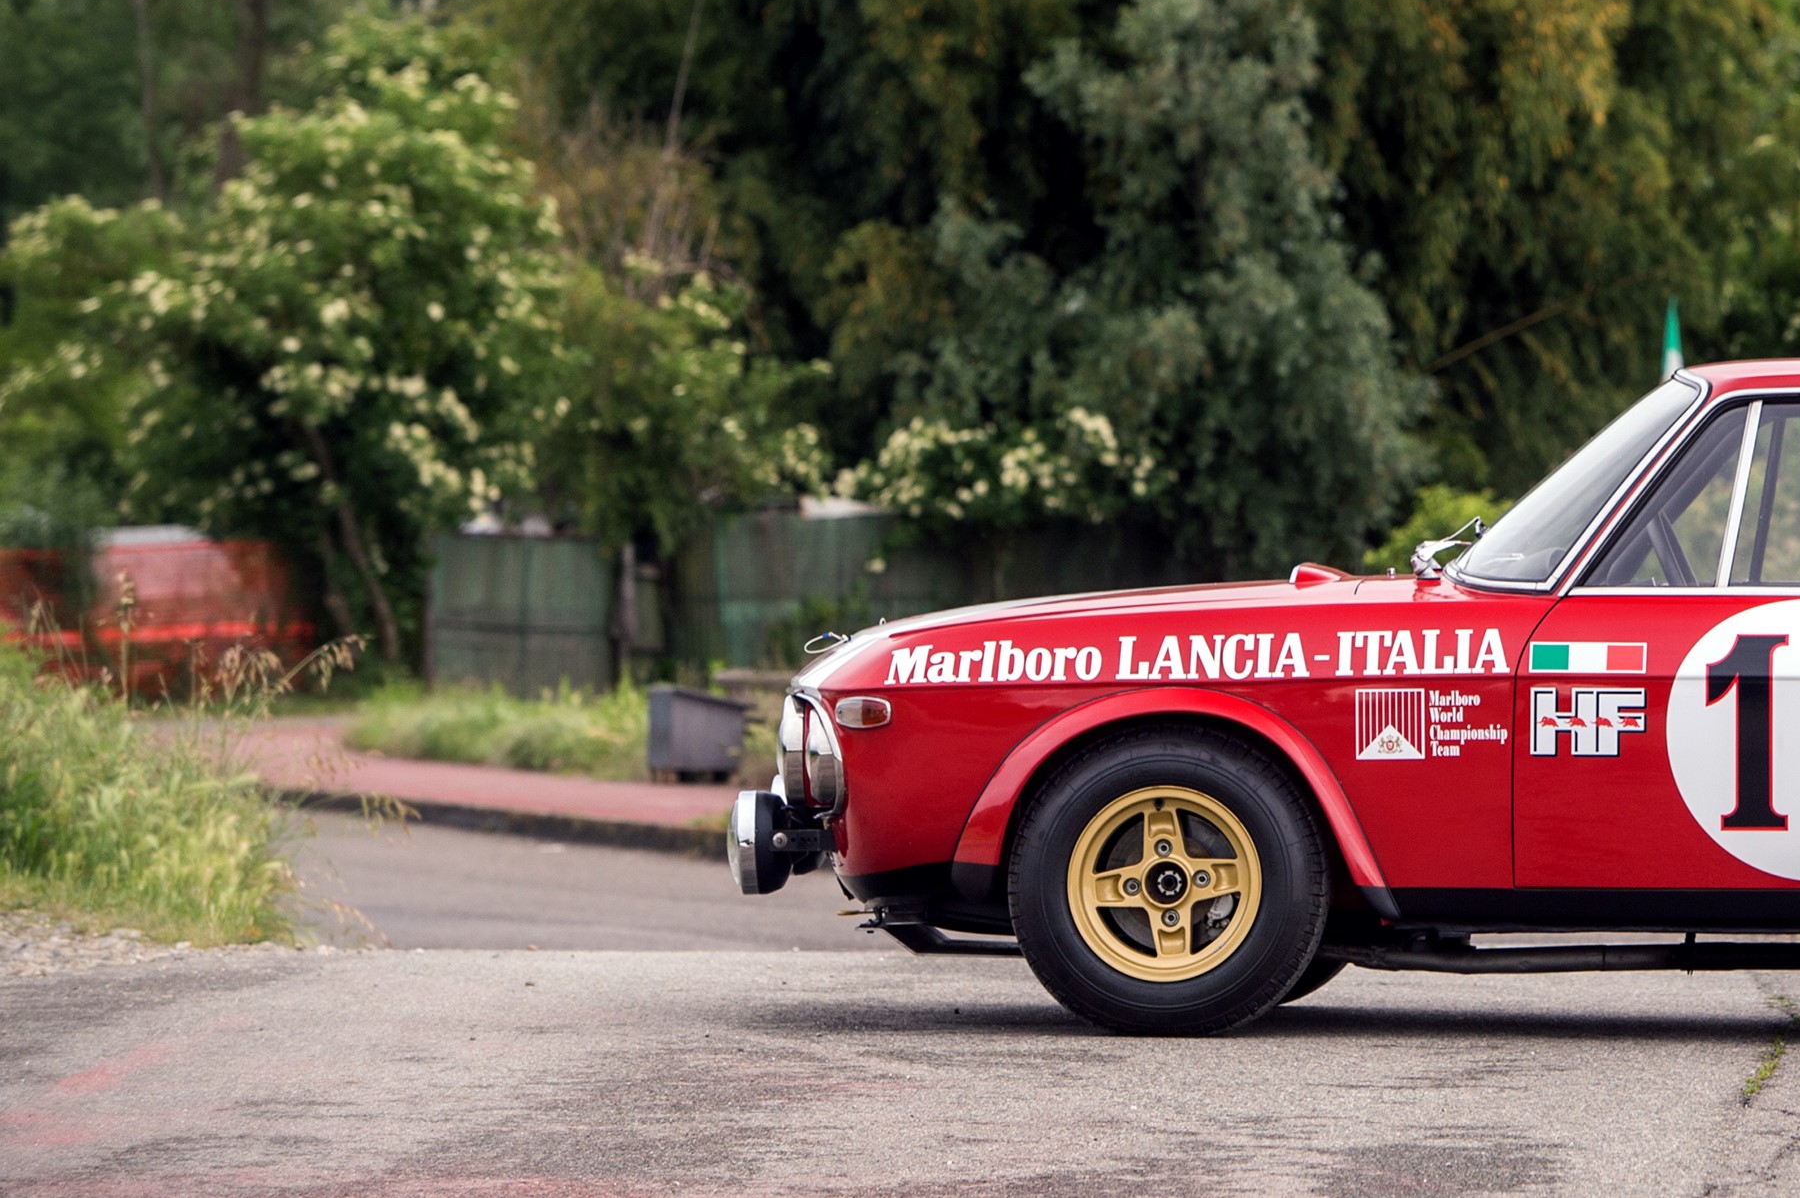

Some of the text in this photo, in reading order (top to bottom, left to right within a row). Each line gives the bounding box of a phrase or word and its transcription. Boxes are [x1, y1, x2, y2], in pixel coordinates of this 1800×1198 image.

[883, 639, 1102, 685] Marlboro
[1429, 690, 1480, 706] Marlboro
[1429, 707, 1463, 722] World
[1529, 686, 1648, 757] HF
[1429, 724, 1507, 745] Championship
[1430, 740, 1460, 756] Team
